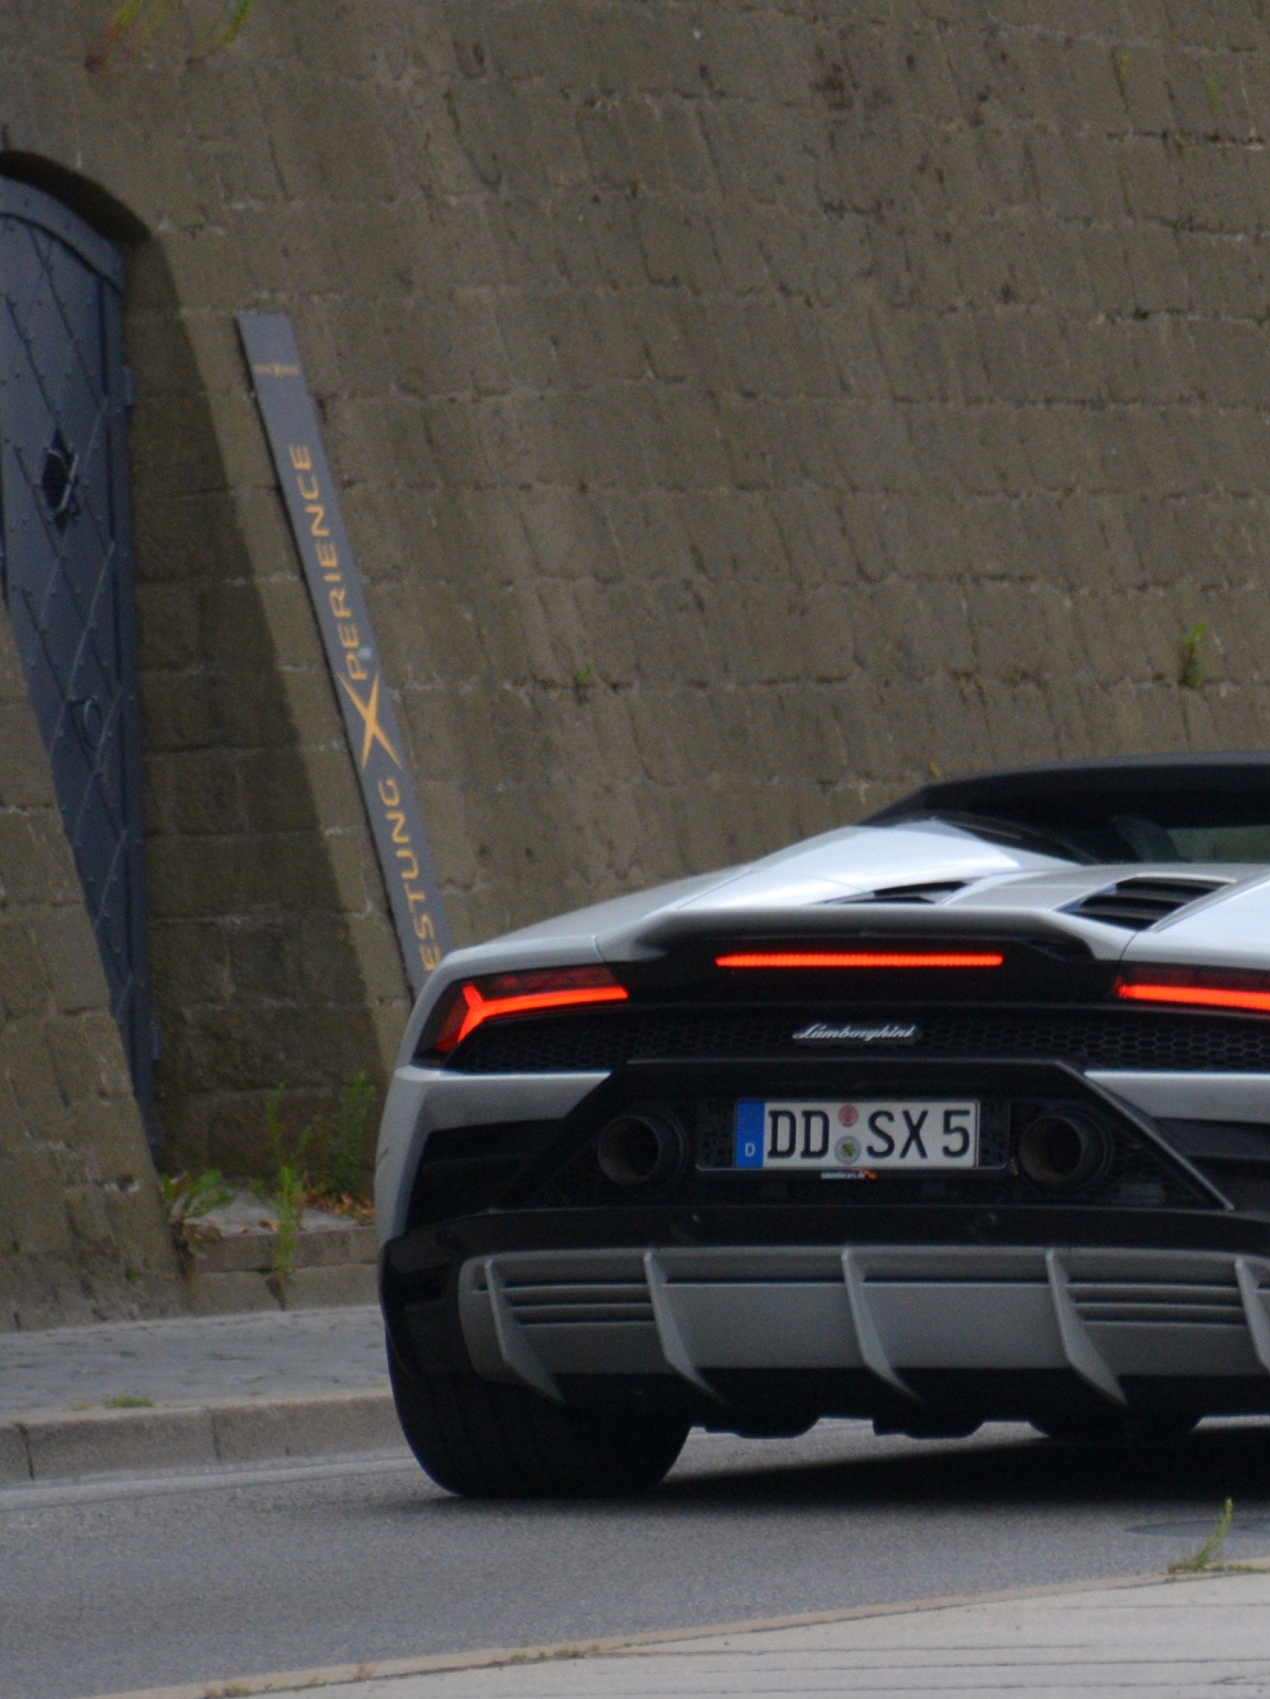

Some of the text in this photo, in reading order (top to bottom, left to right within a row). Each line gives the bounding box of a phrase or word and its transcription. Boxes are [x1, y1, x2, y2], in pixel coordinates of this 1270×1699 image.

[378, 777, 441, 971] ESTUNG
[792, 1023, 916, 1042] Lamborghini
[744, 1142, 755, 1158] D
[767, 1109, 971, 1159] DD SX 5
